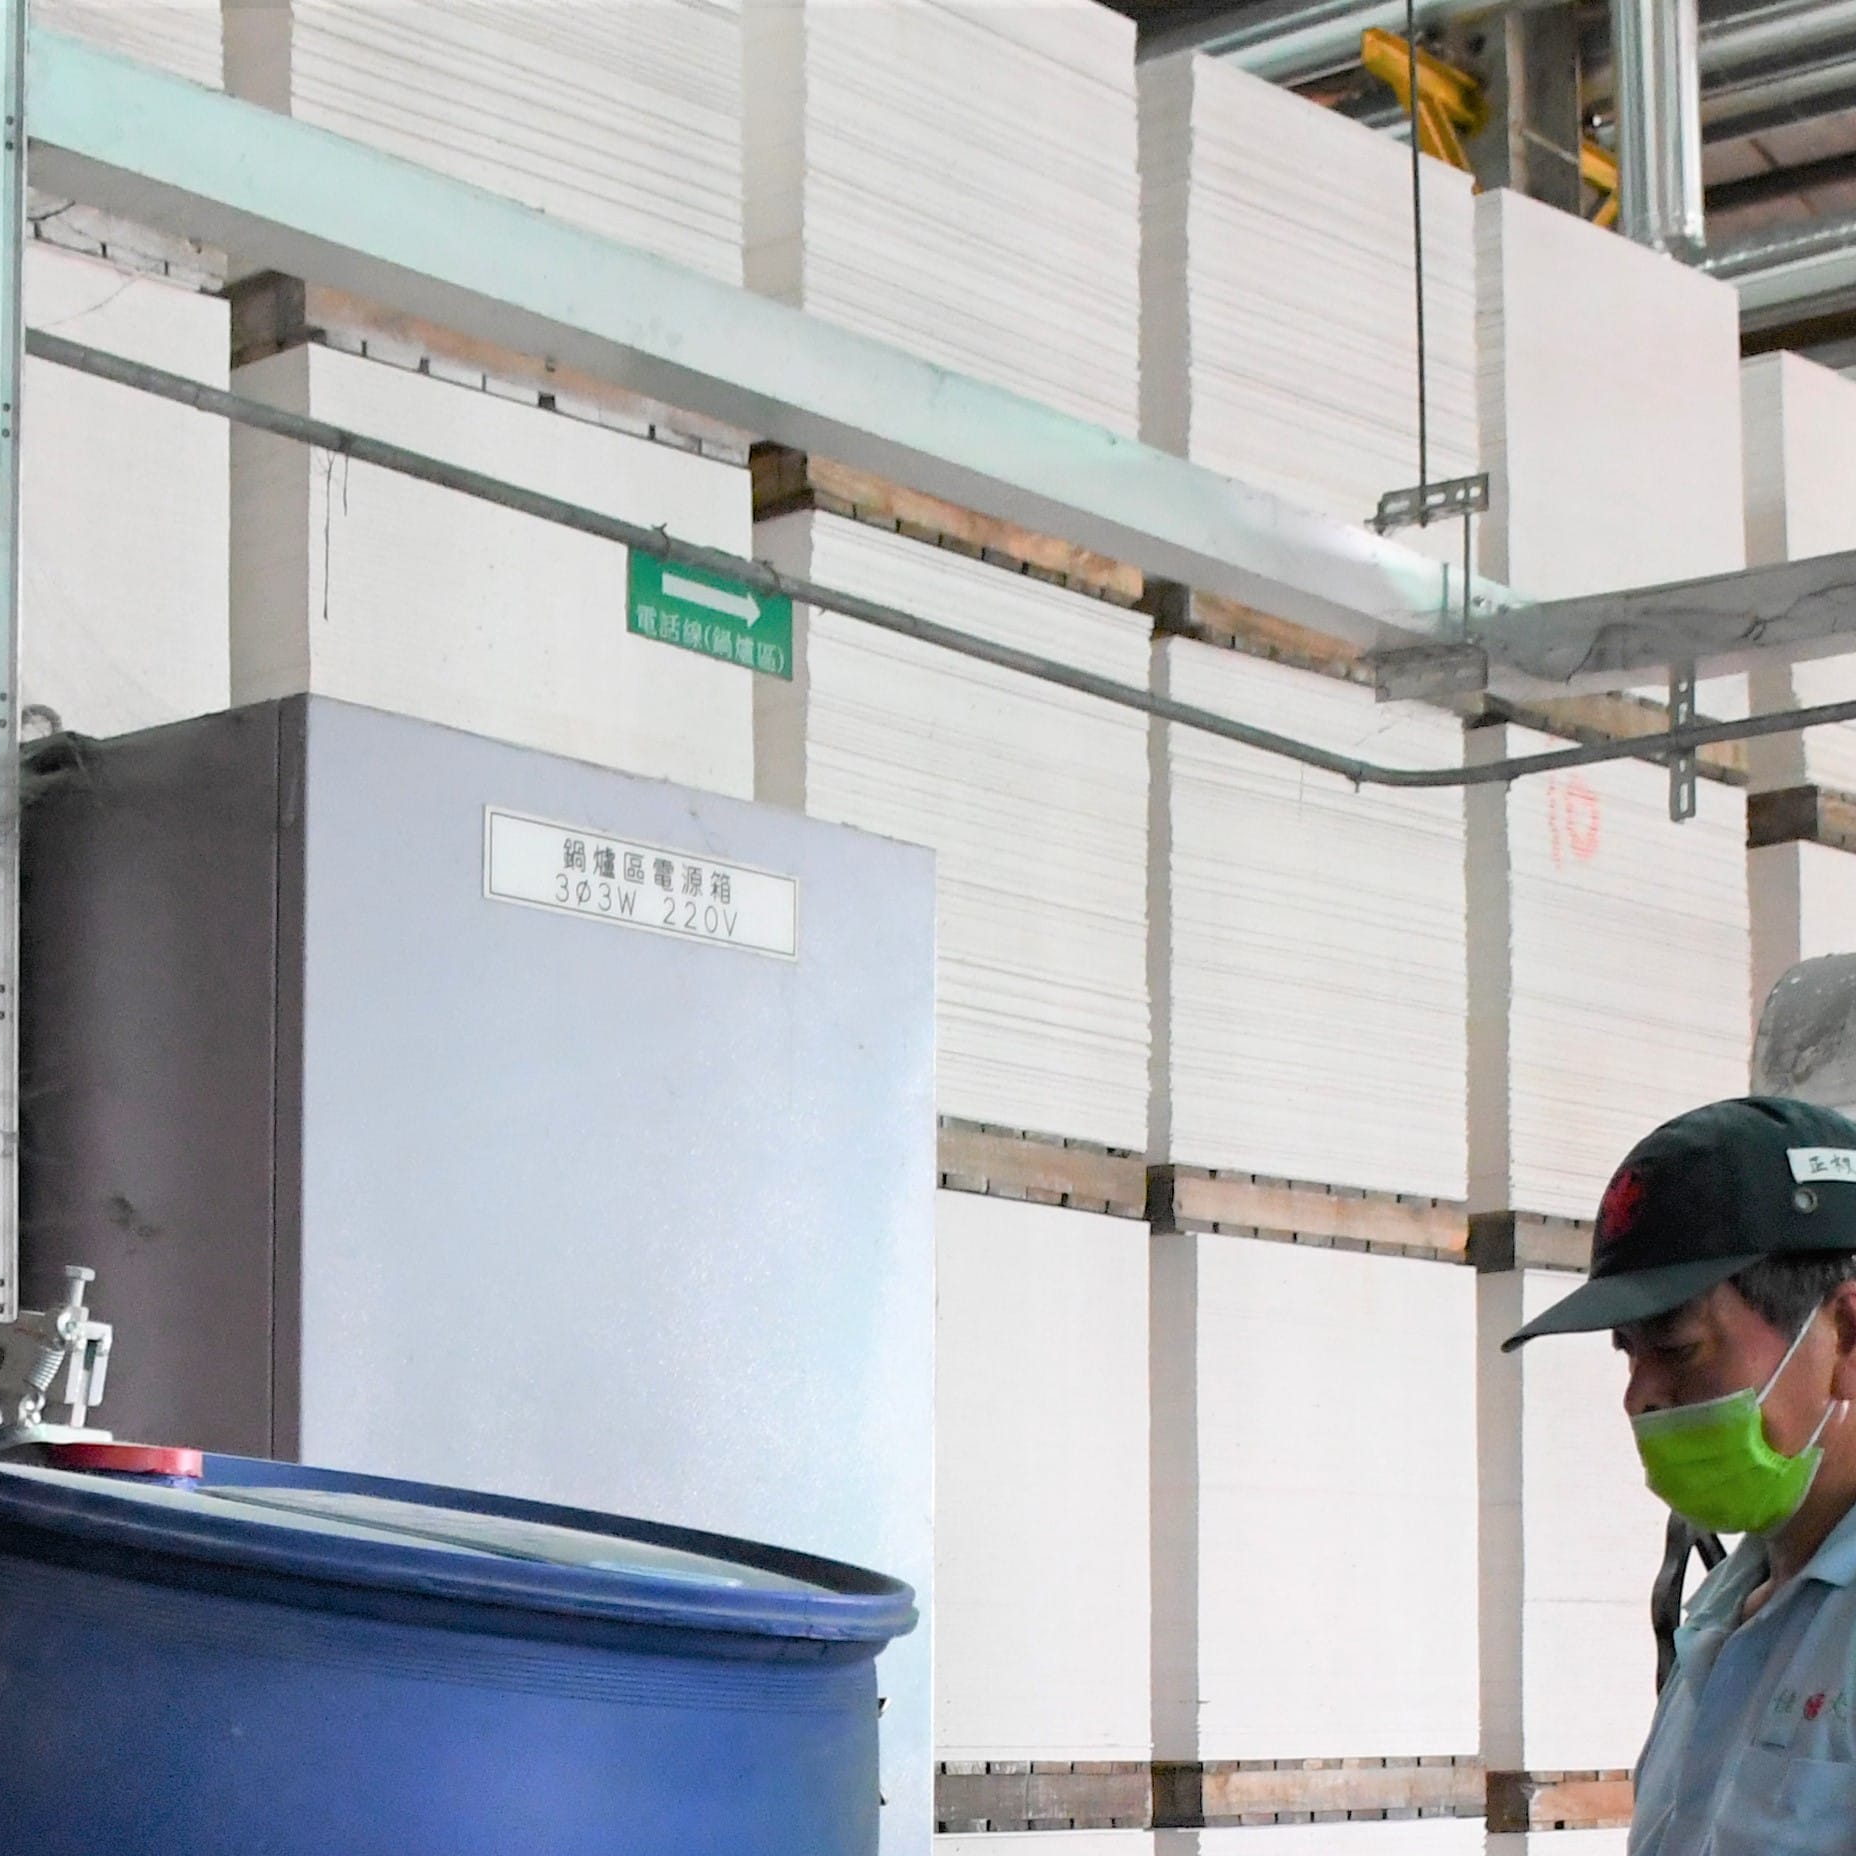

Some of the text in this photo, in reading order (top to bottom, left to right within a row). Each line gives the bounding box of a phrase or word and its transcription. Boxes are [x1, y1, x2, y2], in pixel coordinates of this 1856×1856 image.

[636, 603, 785, 673] 電話線(鍋爐區)
[562, 837, 733, 905] 鍋爐區電源箱
[662, 896, 738, 937] 220V
